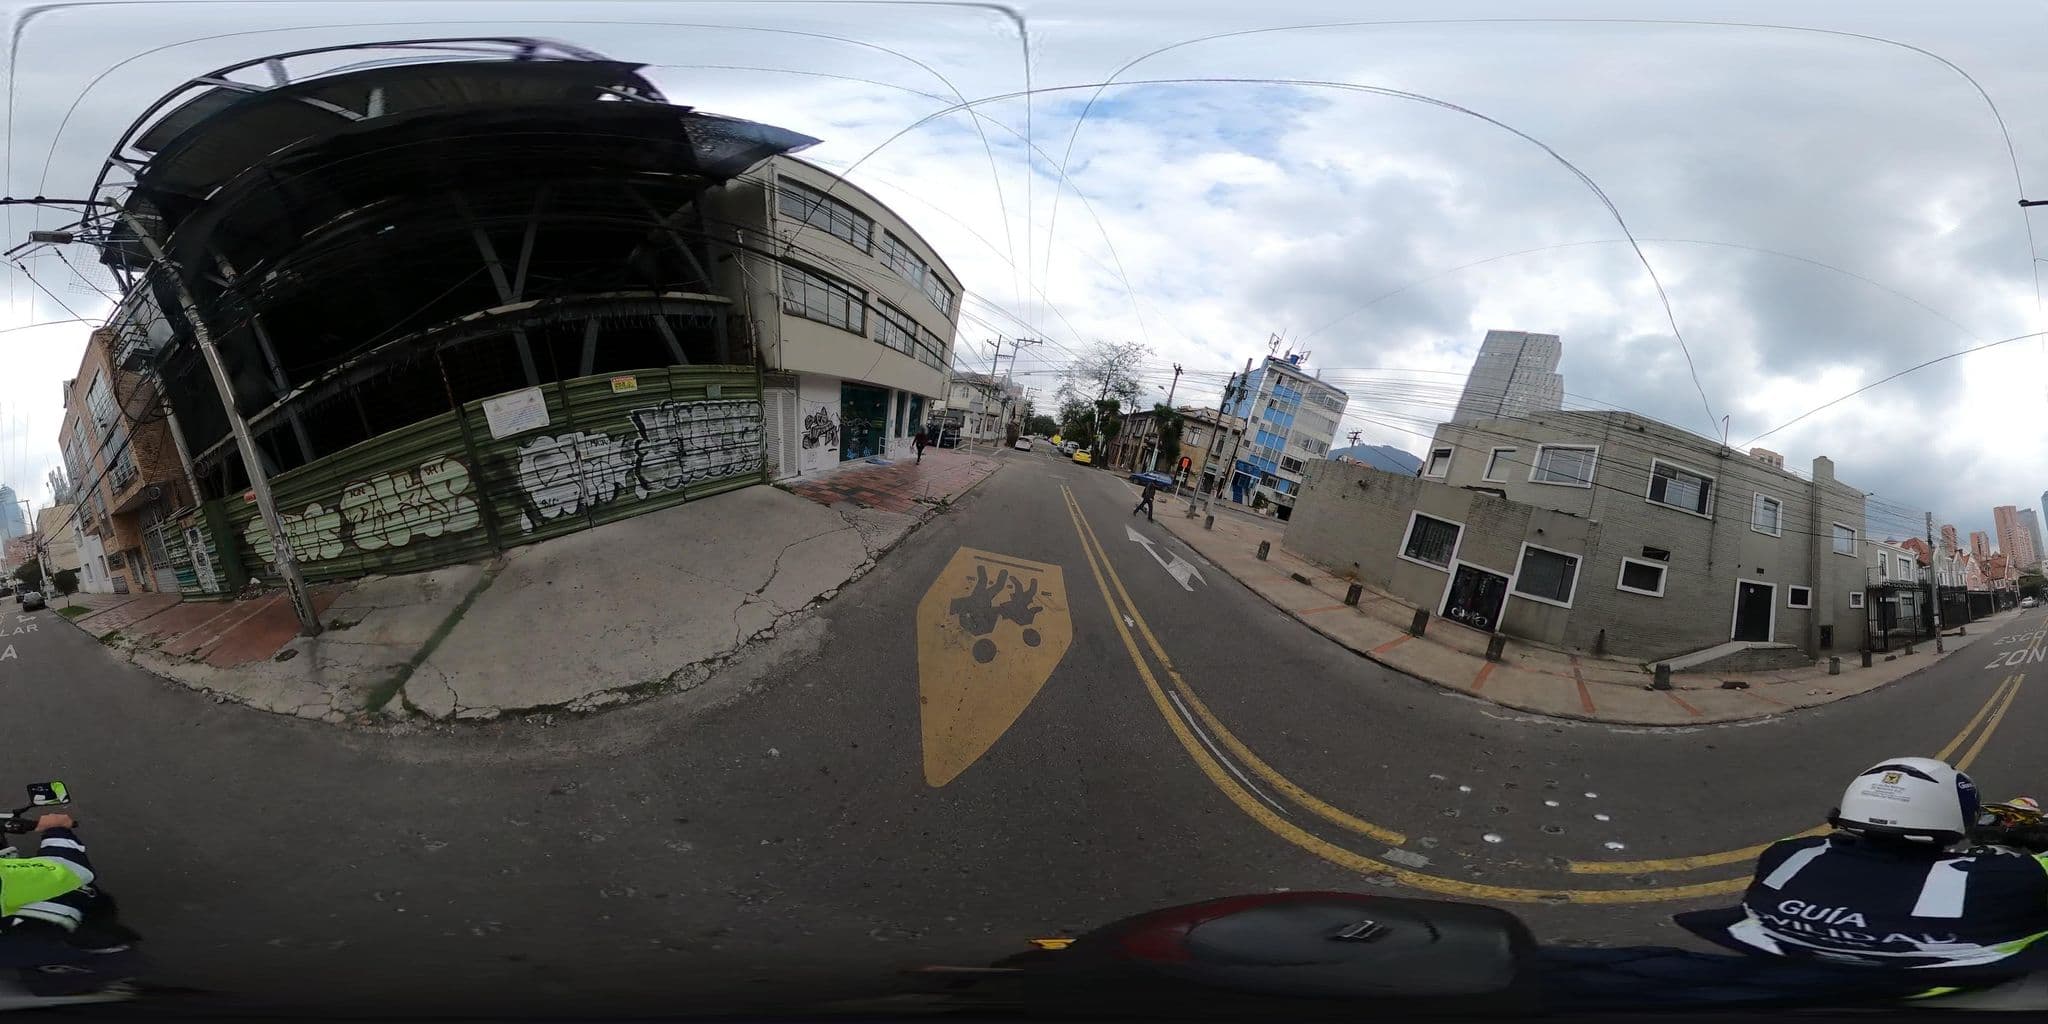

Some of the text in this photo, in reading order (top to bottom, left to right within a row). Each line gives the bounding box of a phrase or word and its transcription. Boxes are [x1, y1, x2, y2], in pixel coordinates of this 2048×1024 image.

[0, 624, 39, 636] LAR
[0, 644, 18, 661] A
[1984, 646, 2048, 669] ZON
[1777, 899, 1867, 928] GUÍA
